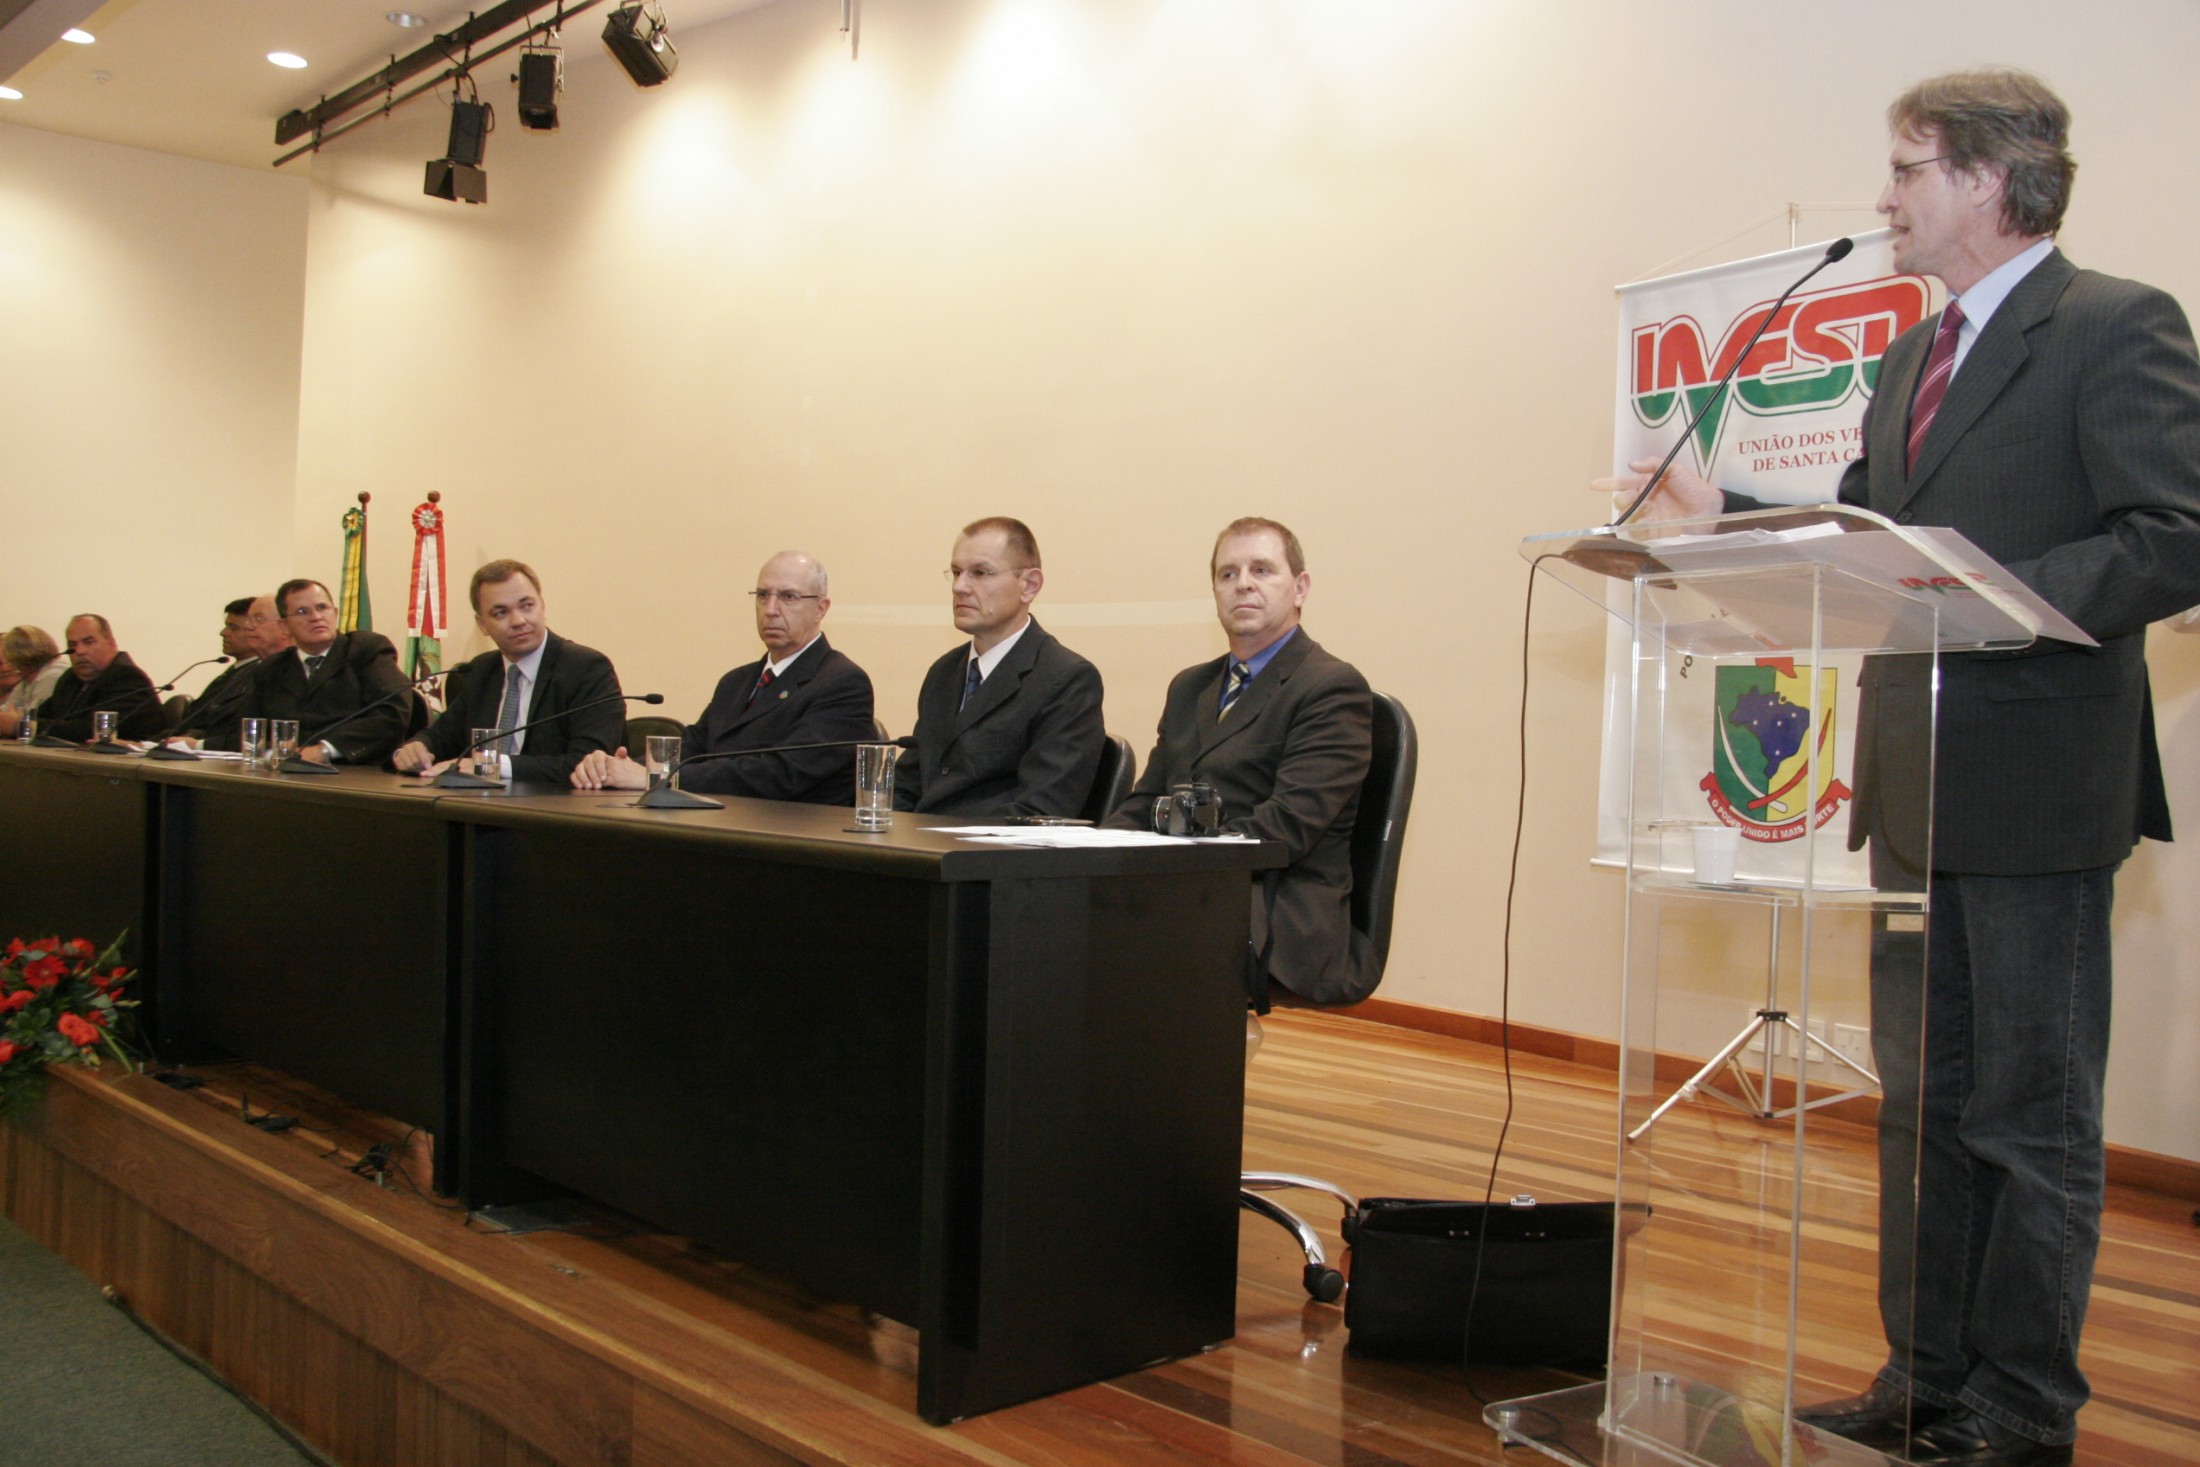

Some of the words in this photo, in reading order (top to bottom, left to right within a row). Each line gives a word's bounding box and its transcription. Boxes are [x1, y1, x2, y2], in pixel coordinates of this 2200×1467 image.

[1738, 434, 1793, 455] UNIÃO
[1799, 430, 1835, 447] DOS
[1752, 457, 1776, 472] DE
[1779, 450, 1838, 469] SANTA
[1711, 799, 1719, 808] O
[1742, 825, 1771, 839] UNIDO
[1772, 829, 1779, 839] É
[1781, 824, 1804, 839] MAIS
